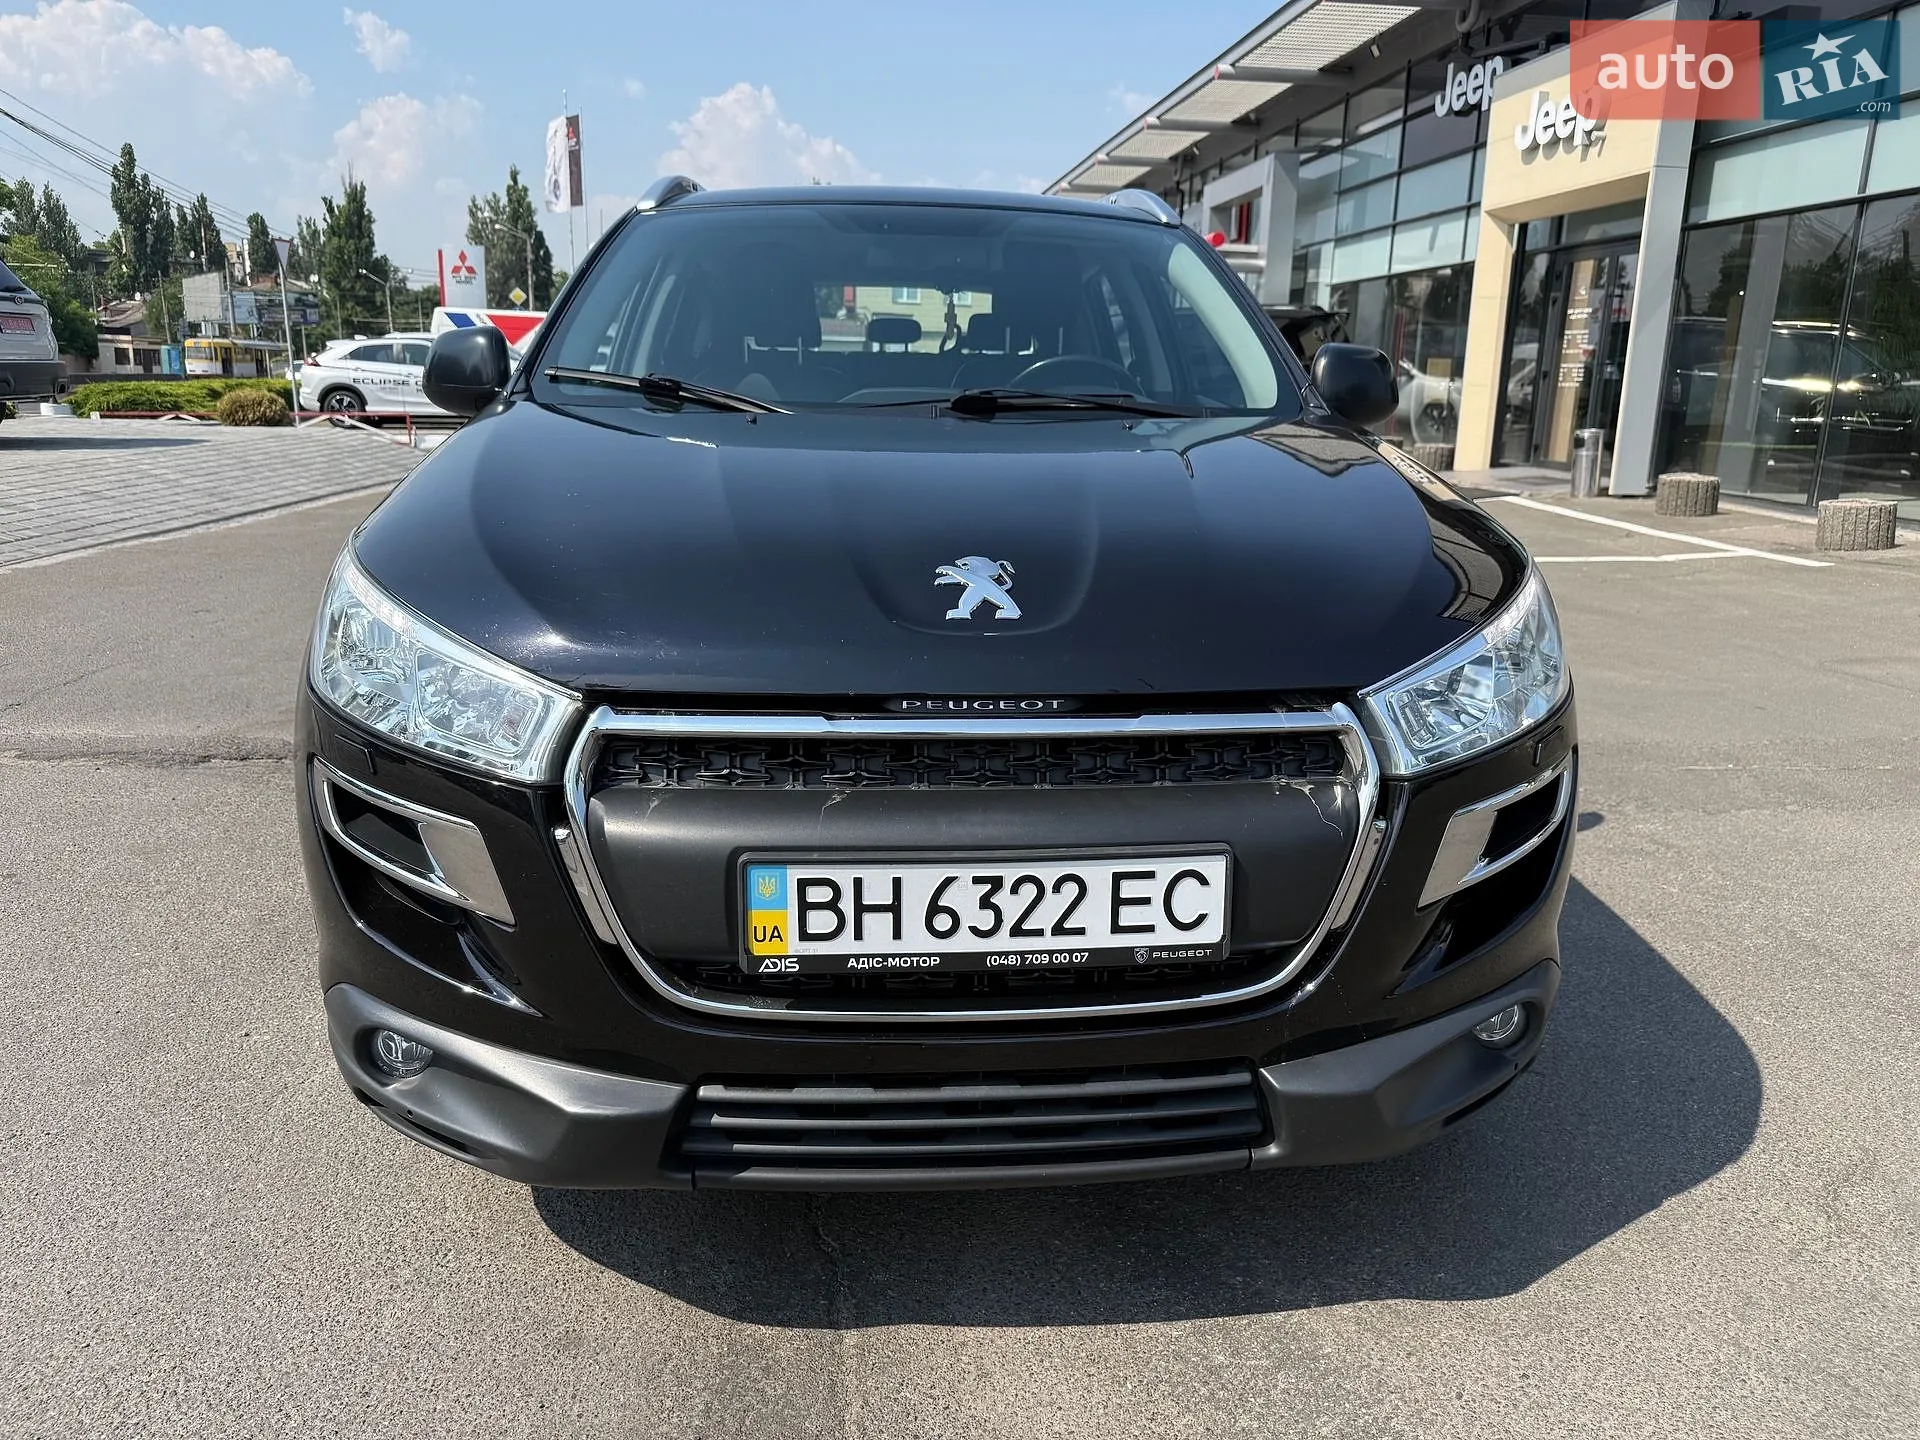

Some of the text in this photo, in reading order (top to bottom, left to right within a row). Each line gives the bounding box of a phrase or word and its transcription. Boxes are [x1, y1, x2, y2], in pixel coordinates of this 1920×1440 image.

[1435, 55, 1504, 118] Jeep
[1514, 89, 1602, 151] Jeep
[353, 378, 410, 386] ECLIPSE
[902, 700, 1064, 710] PEUGEOT
[797, 869, 1210, 942] BH 6322 EC
[753, 925, 784, 943] UA
[986, 952, 1089, 967] (048) 709 00 07
[1152, 949, 1213, 959] PEUGEOT
[758, 957, 800, 973] ADIS
[847, 956, 940, 970] АДІС-МОТОР
